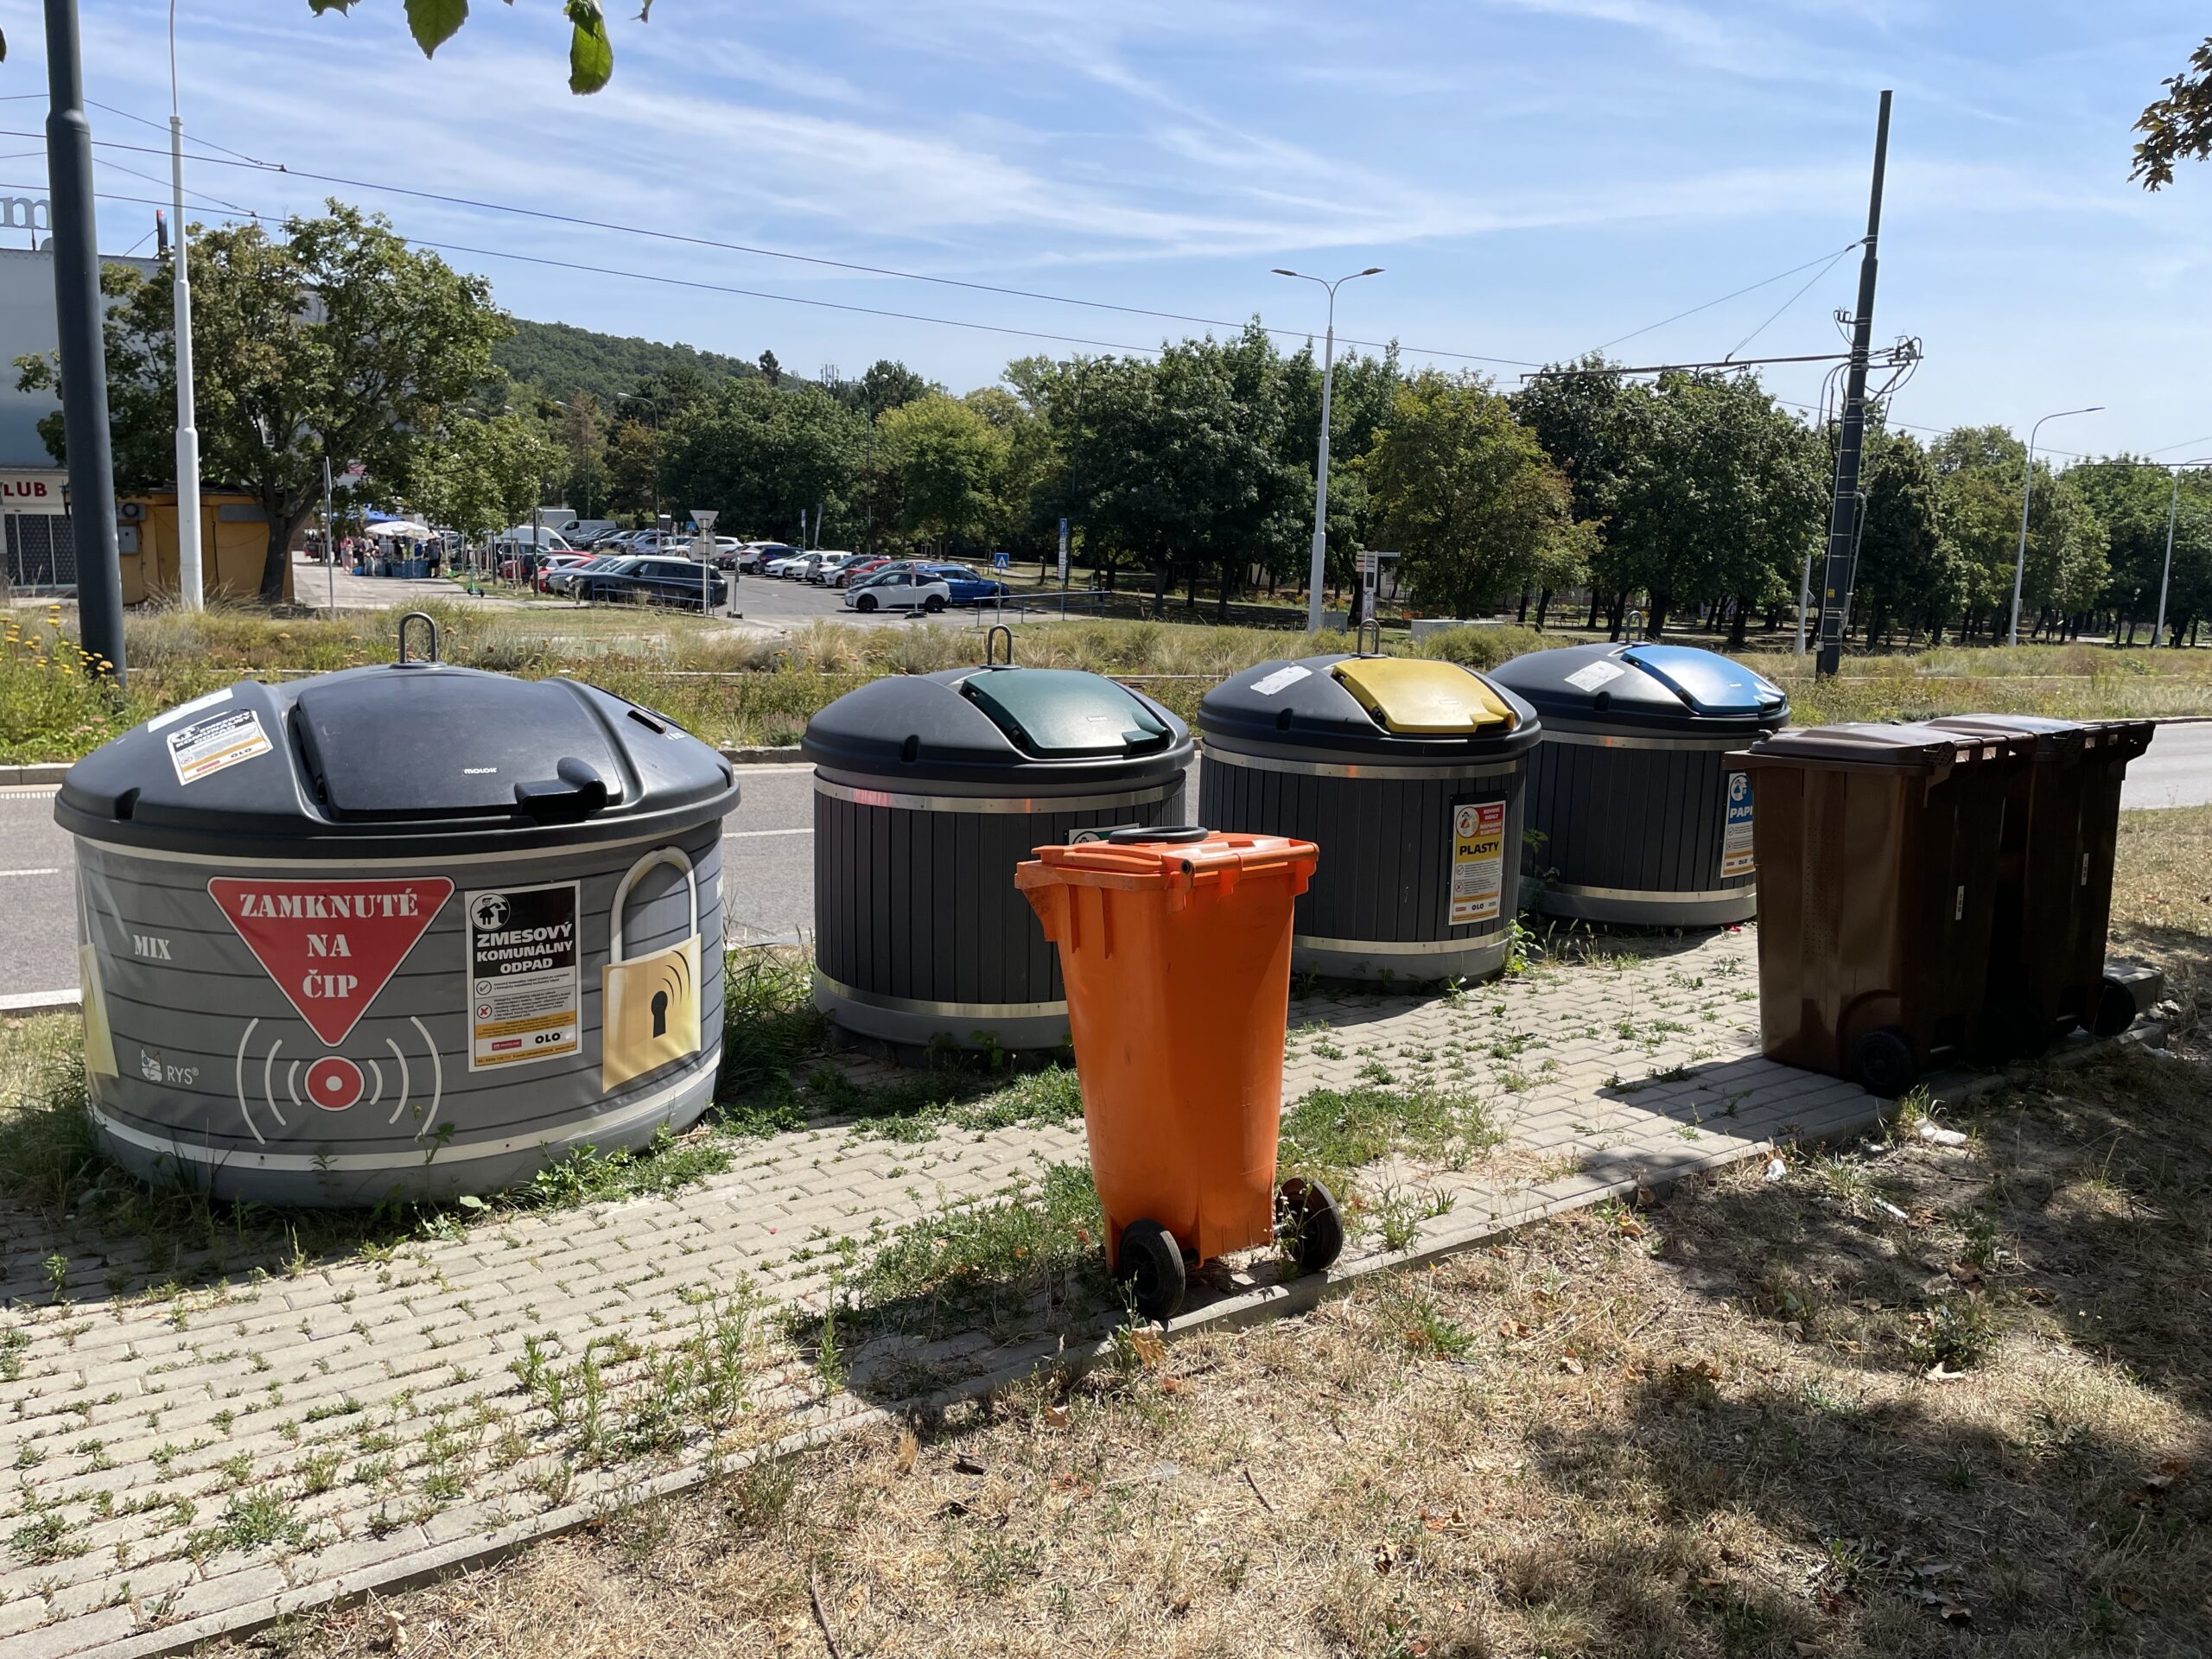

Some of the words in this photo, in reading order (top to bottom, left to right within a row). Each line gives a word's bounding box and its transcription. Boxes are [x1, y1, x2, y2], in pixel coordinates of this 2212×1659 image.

[3, 481, 48, 497] LUB
[231, 747, 252, 759] OLO
[1459, 841, 1499, 856] PLASTY
[239, 888, 419, 918] ZAMKNUTÉ
[306, 933, 352, 957] NA
[476, 920, 573, 948] ZMESOVÝ
[133, 934, 172, 961] MIX
[476, 940, 573, 963] KOMUNÁLNY
[499, 957, 553, 974] ODPAD
[302, 969, 359, 999] ČIP
[535, 1032, 562, 1045] OLO
